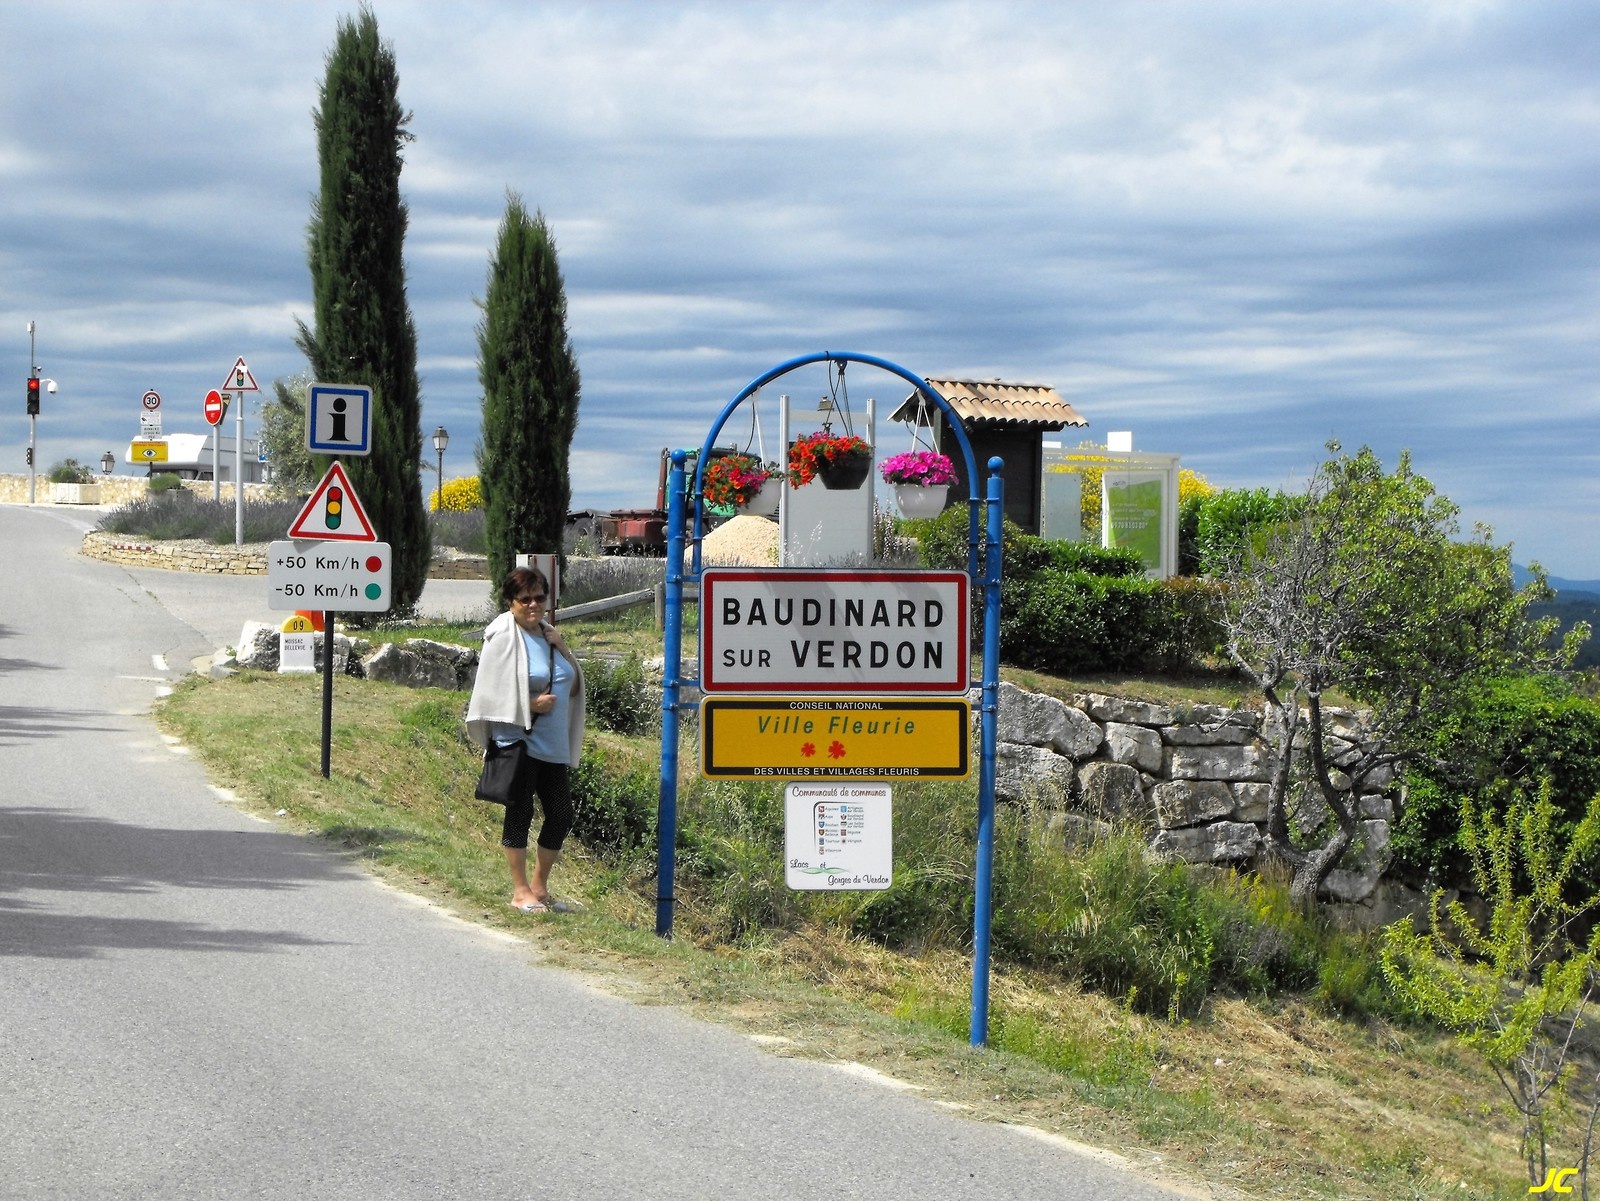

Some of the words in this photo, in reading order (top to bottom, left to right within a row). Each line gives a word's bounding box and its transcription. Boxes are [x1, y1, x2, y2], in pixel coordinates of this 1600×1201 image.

[146, 397, 157, 405] 30
[277, 556, 306, 570] +50
[316, 556, 359, 570] Km/h
[275, 584, 305, 597] -50
[314, 583, 358, 598] Km/h
[722, 598, 944, 628] BAUDINARD
[722, 649, 771, 668] SUR
[790, 640, 943, 669] VERDON
[789, 701, 832, 710] CONSEIL
[835, 702, 883, 710] NATIONAL
[758, 715, 814, 734] Ville
[828, 716, 916, 734] Fleurie
[754, 767, 774, 776] DES
[775, 767, 811, 776] VILLES
[813, 767, 826, 776] ET
[828, 767, 875, 776] VILLAGES
[878, 767, 919, 776] FLEURIS
[792, 786, 838, 797] Communauté
[840, 787, 849, 797] de
[851, 789, 886, 797] communes
[790, 859, 809, 868] Lacs
[828, 874, 852, 886] Gorges
[853, 875, 861, 884] du
[862, 875, 889, 884] Verdon
